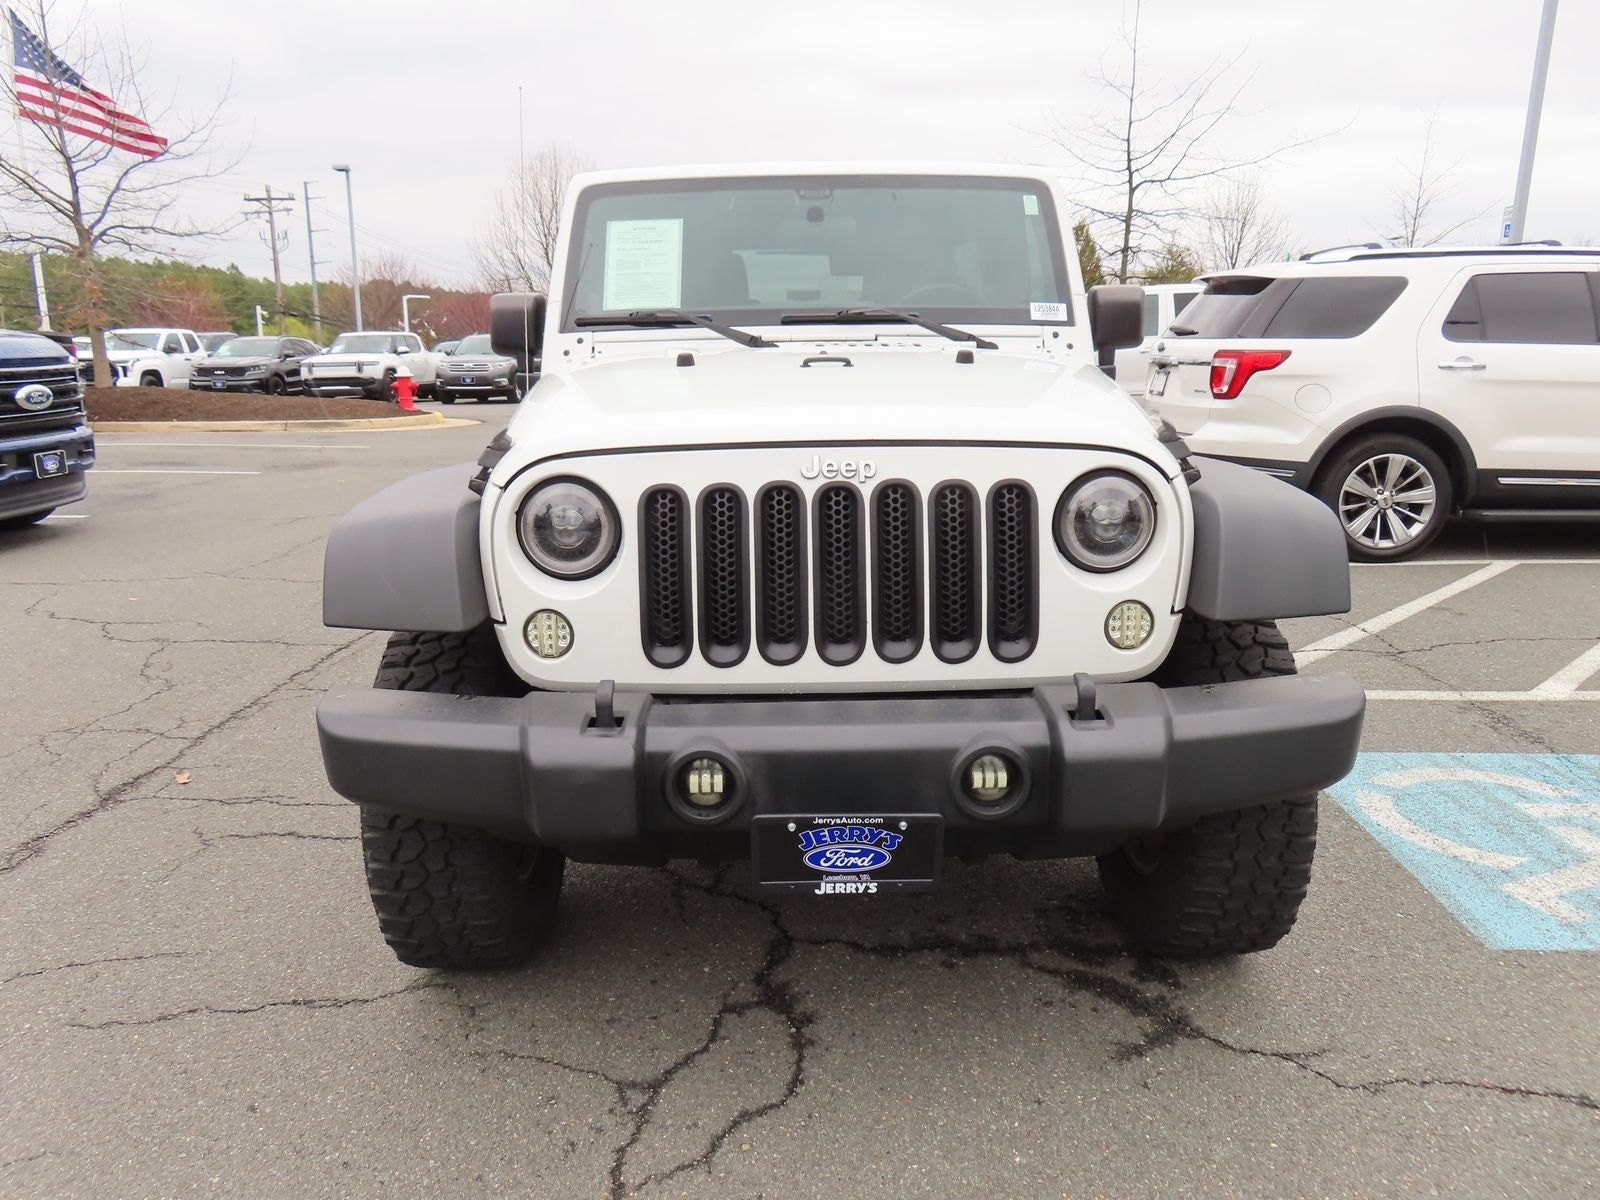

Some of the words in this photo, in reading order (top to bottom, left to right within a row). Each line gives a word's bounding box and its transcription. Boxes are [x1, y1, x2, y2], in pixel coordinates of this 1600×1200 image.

[800, 455, 877, 484] Jeep
[812, 816, 884, 826] JerrysAuto.com
[798, 826, 903, 850] JERRY'S
[820, 849, 874, 866] Ford
[814, 881, 878, 895] JERRY'S
